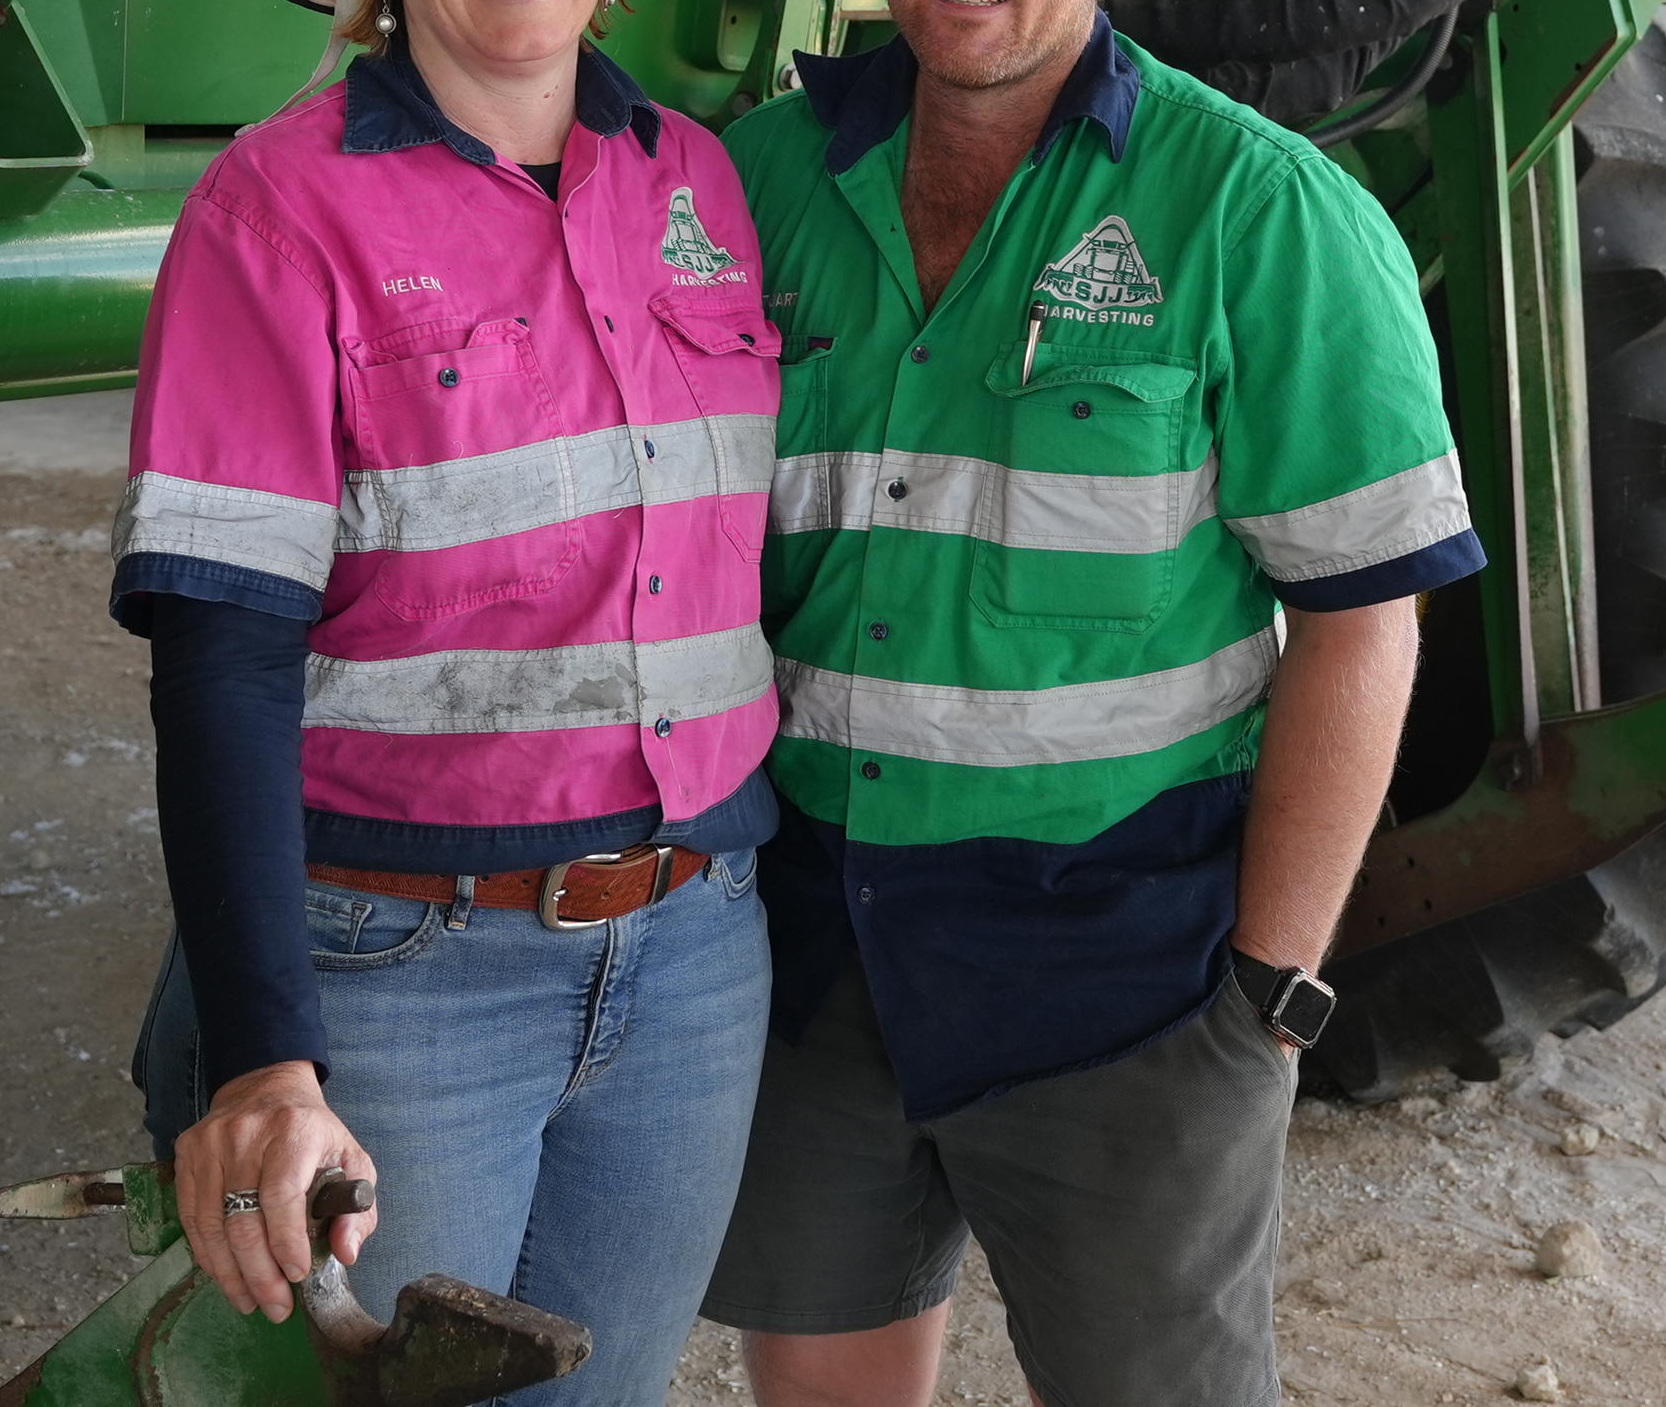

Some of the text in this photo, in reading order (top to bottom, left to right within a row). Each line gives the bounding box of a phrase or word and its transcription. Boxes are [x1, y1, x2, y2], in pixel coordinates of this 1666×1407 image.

[382, 275, 444, 297] HELEN
[1074, 280, 1124, 305] SJJ
[762, 291, 800, 307] TUART
